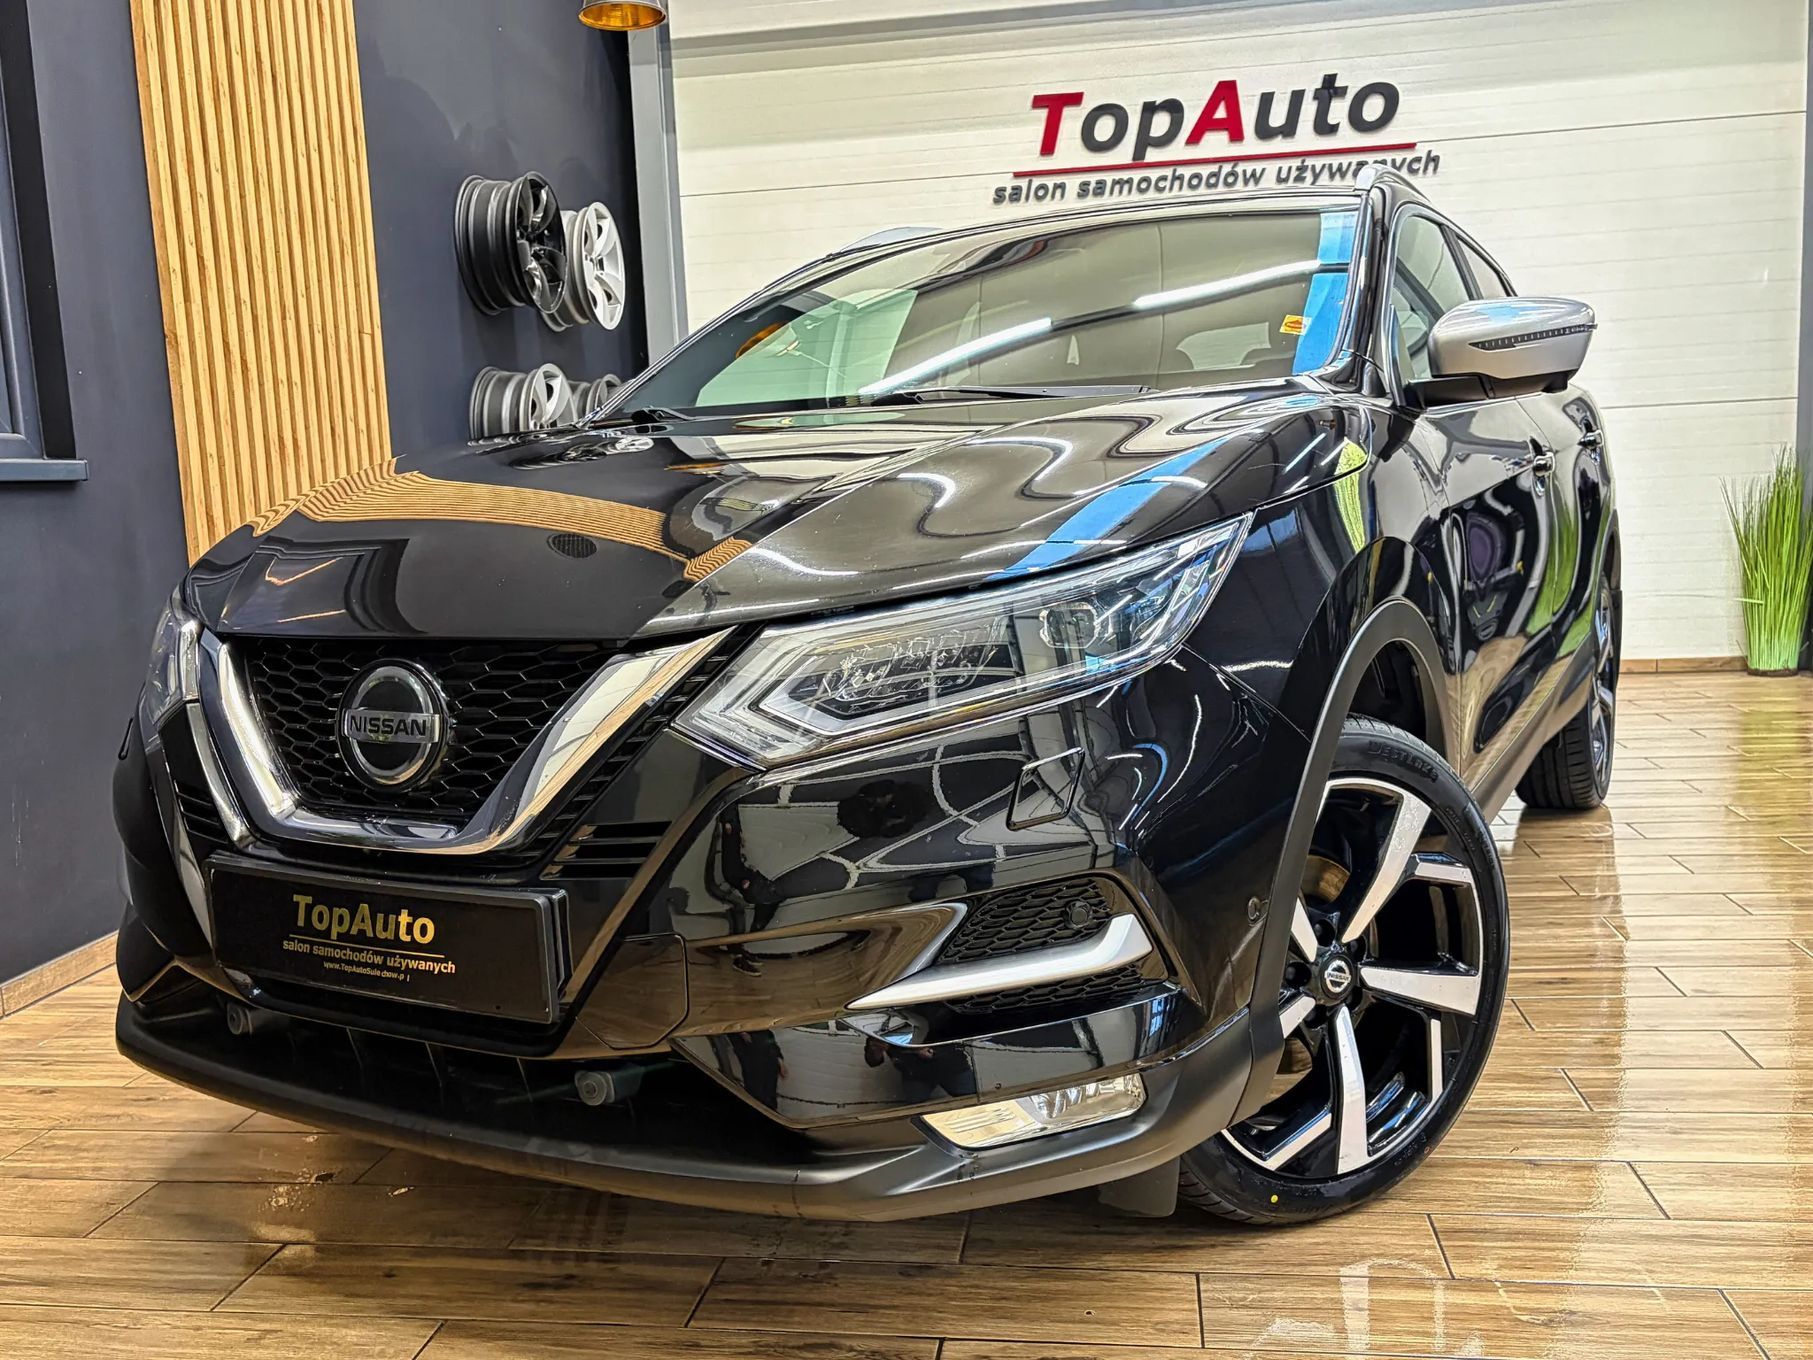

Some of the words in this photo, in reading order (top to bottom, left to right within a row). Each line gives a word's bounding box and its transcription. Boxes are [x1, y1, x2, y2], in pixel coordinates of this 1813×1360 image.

[1031, 73, 1400, 161] TopAuto
[993, 179, 1067, 205] salon
[1077, 161, 1266, 199] samochodów
[349, 715, 427, 737] NISSAN
[293, 894, 435, 944] TopAuto
[283, 939, 310, 955] salon
[312, 943, 384, 965] samochodów
[387, 954, 456, 974] używanych
